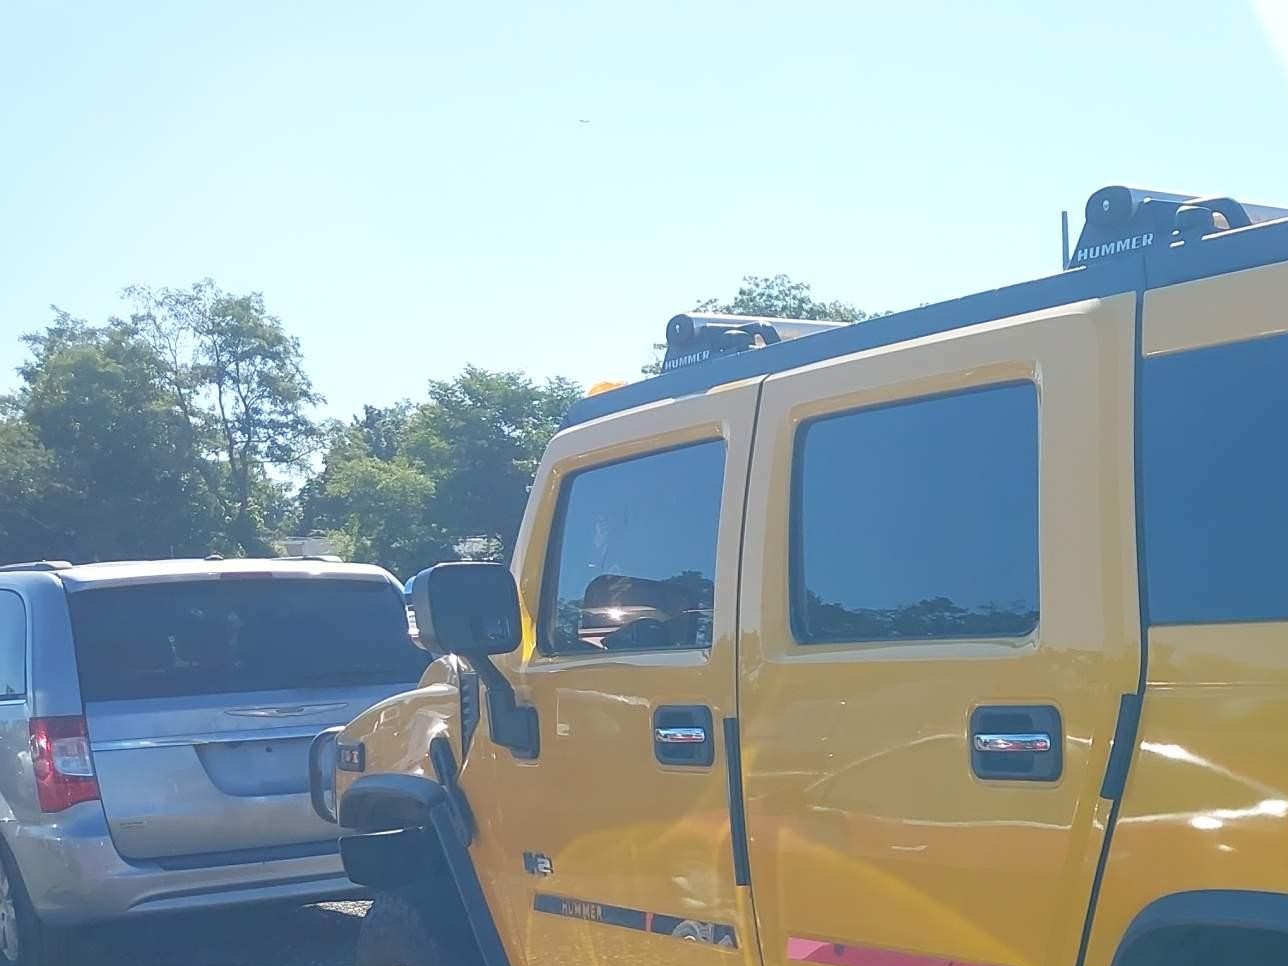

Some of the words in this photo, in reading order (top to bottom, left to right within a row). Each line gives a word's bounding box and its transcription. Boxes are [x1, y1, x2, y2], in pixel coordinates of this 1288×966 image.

[1077, 233, 1154, 262] HUMMER
[664, 350, 710, 370] HUMMER
[560, 899, 603, 921] HUMMER
